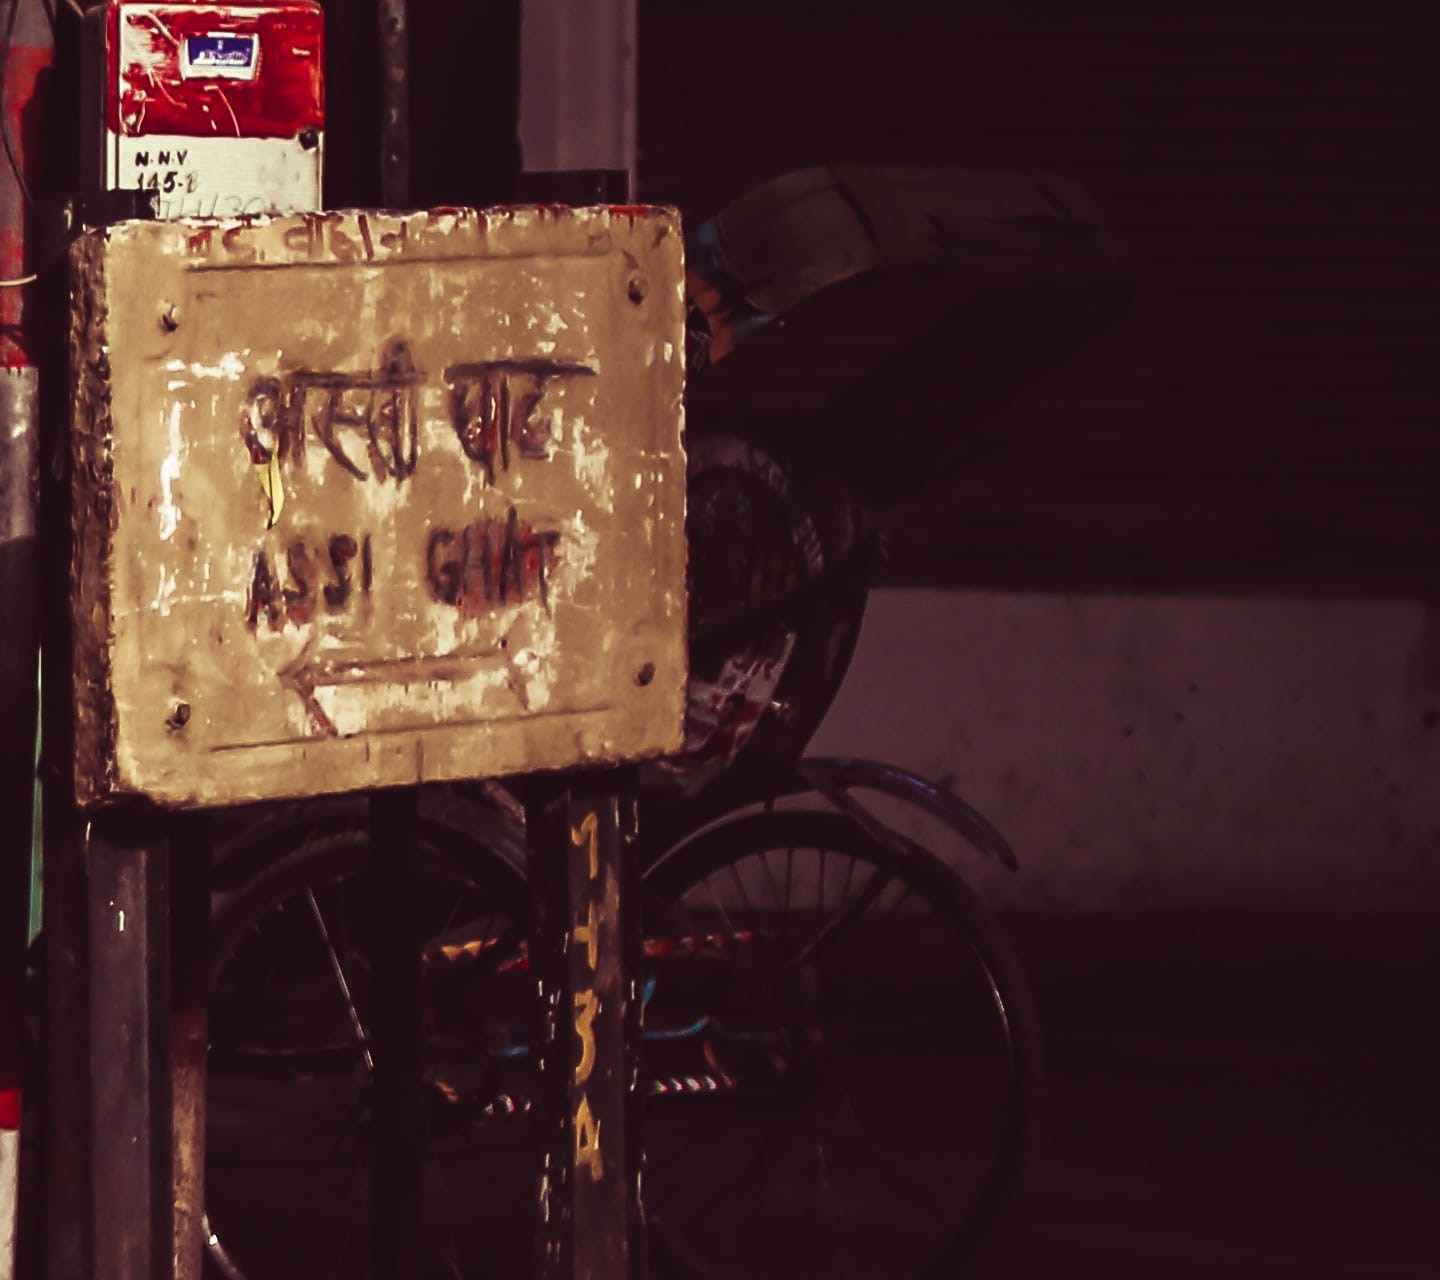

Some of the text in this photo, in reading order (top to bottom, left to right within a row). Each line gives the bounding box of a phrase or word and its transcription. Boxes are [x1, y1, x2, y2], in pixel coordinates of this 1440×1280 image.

[440, 358, 598, 488] घाट
[245, 505, 560, 630] ASSI GHAT
